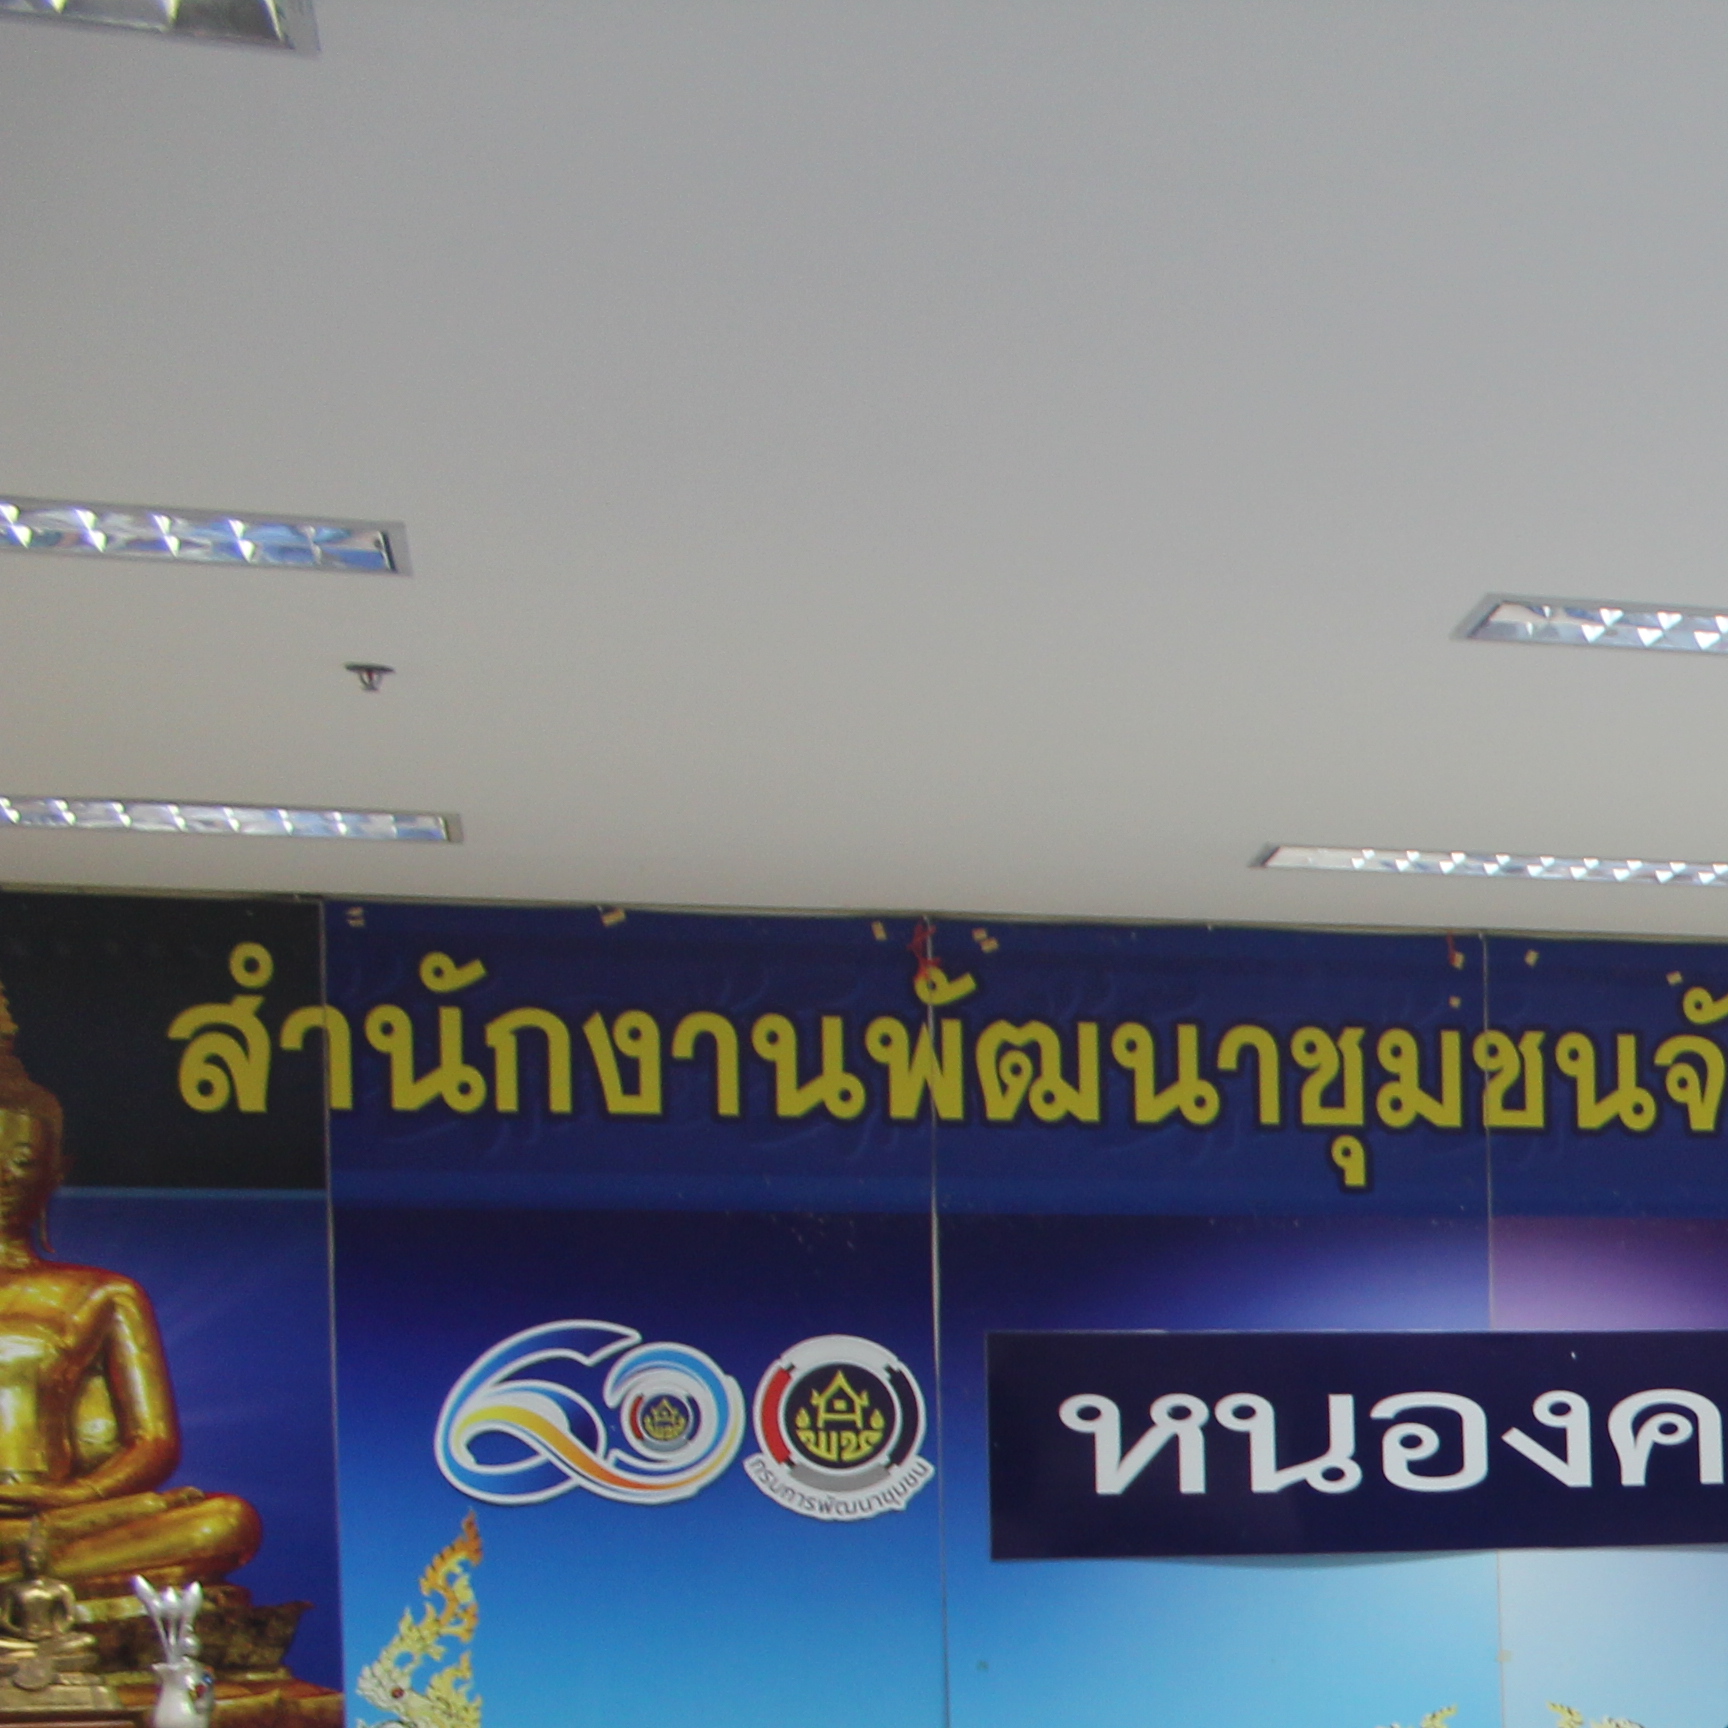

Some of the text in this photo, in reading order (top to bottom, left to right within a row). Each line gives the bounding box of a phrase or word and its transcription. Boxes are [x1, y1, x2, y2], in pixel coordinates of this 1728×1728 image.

[747, 1455, 933, 1516] กรมการพัฒนาชุมชน
